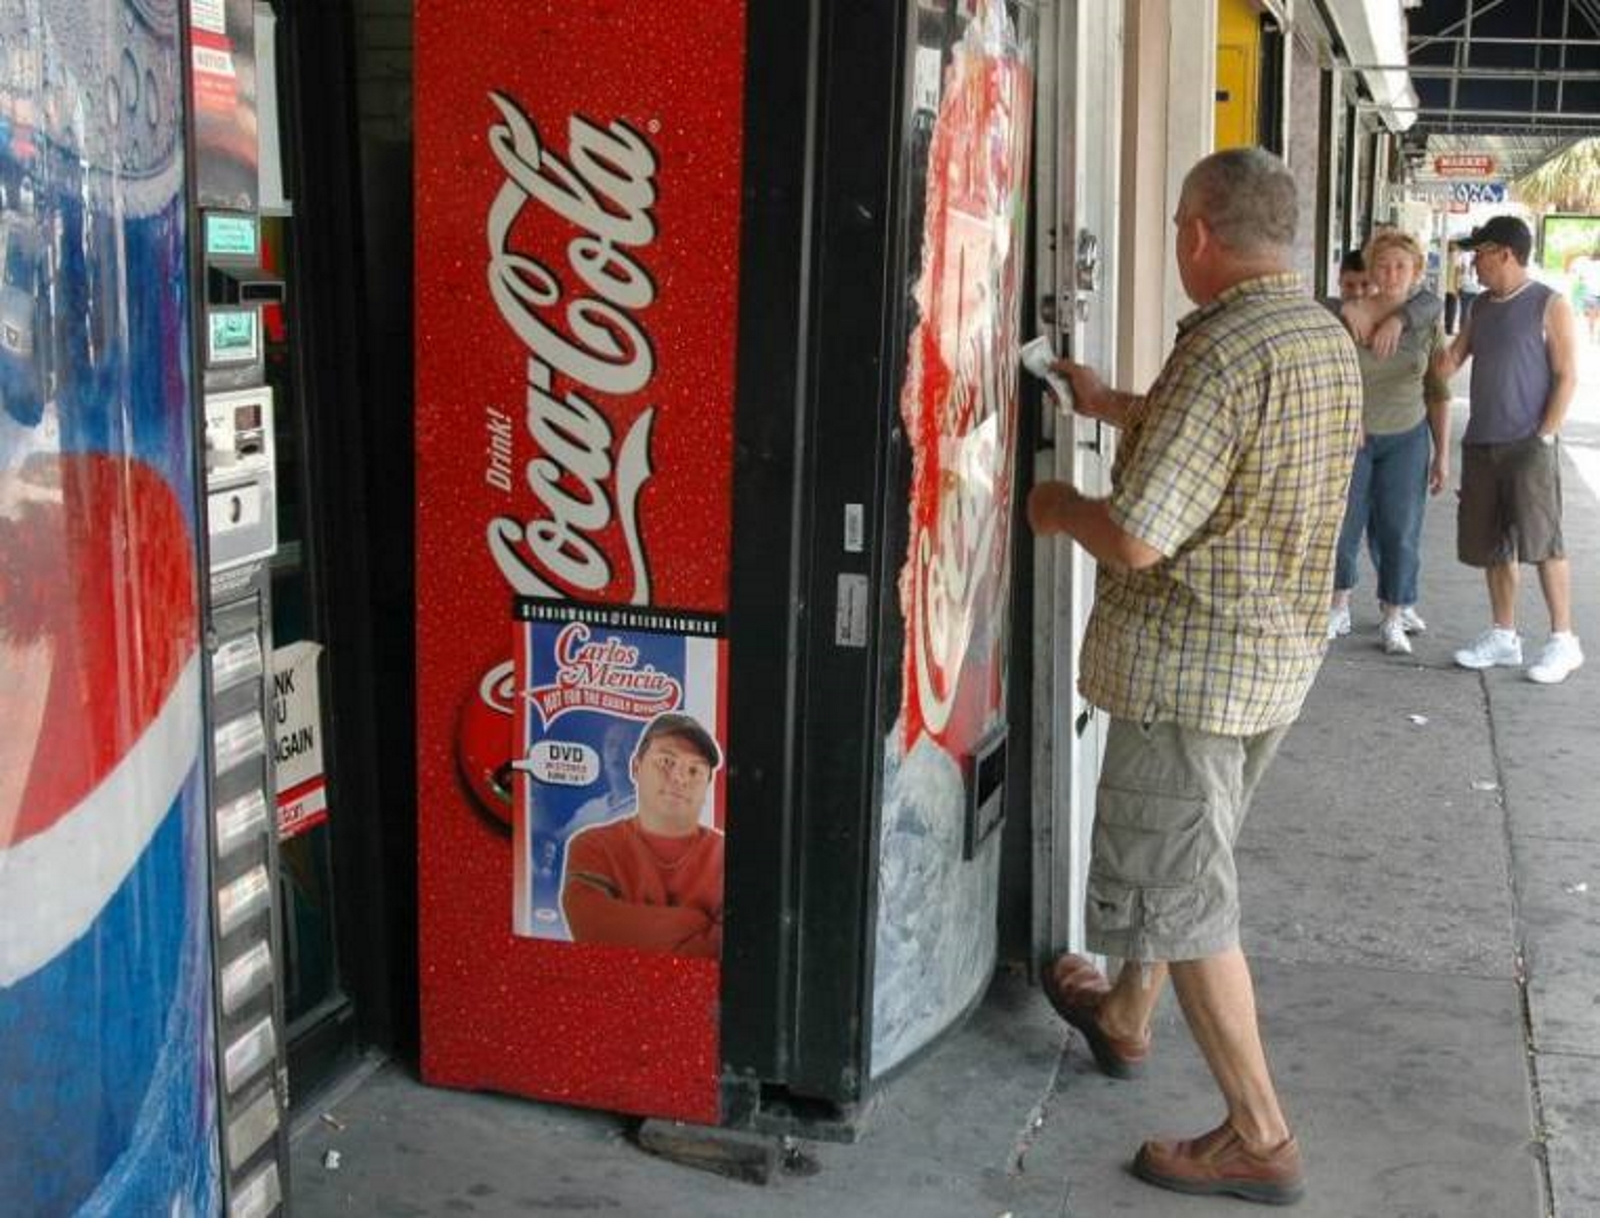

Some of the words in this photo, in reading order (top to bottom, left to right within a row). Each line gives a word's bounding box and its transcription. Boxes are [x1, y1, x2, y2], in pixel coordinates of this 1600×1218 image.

[486, 89, 660, 605] Coca-Cola
[485, 405, 512, 492] Drink!
[556, 623, 637, 665] Carlos
[559, 664, 668, 691] Mencia
[549, 745, 583, 762] DVD
